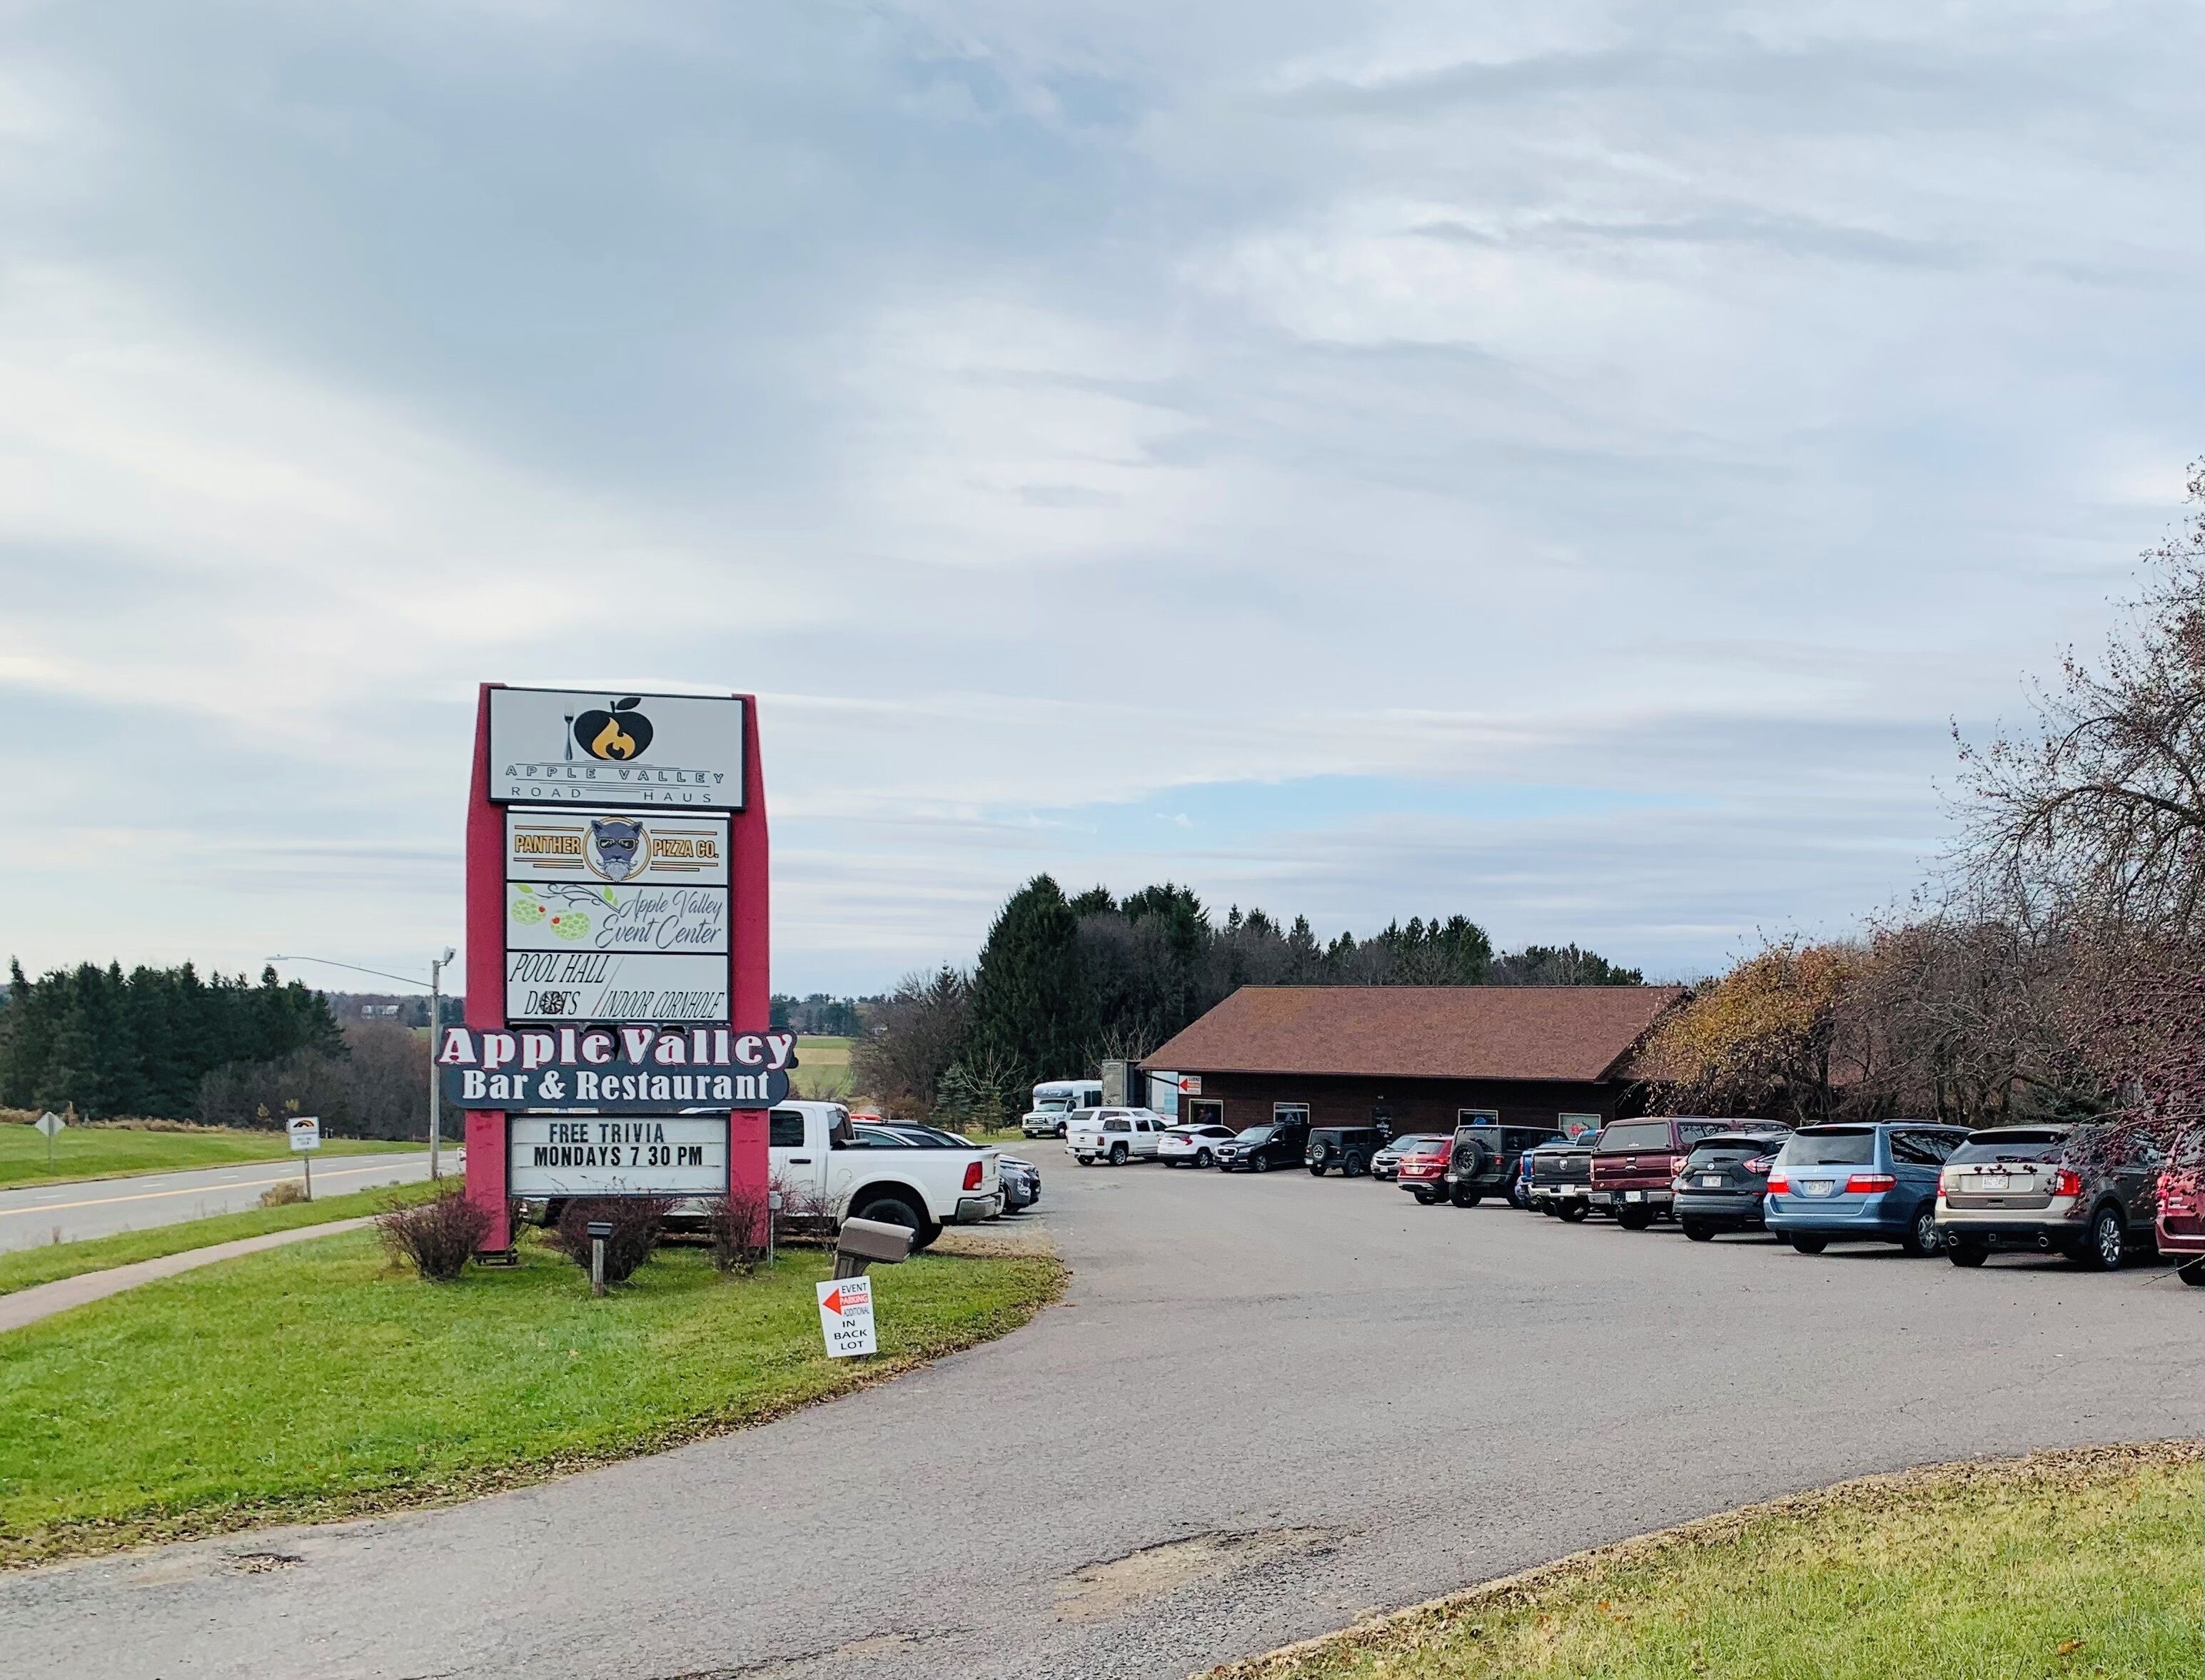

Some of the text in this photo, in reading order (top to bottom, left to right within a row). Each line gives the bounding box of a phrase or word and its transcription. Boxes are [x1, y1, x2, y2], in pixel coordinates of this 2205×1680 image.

[506, 765, 723, 784] APPLE VALLEY
[512, 786, 711, 803] ROAD HAUS
[514, 835, 719, 858] PANTHER PIZZA CO.
[620, 889, 723, 922] Apple Valley
[595, 914, 722, 949] Event Center
[509, 954, 610, 983] POOL HALL
[599, 991, 654, 1018] INDOOR
[652, 991, 725, 1018] CORNHOLE
[440, 1027, 793, 1071] Apple Valley
[463, 1070, 770, 1100] Bar & Restaurant
[550, 1123, 665, 1143] FREE TRIVIA
[534, 1147, 702, 1166] MONDAYS 7 30 PM
[842, 1282, 867, 1294] EVENT
[839, 1294, 868, 1305] PARKING
[834, 1329, 867, 1340] BACK
[841, 1340, 864, 1350] LOT
